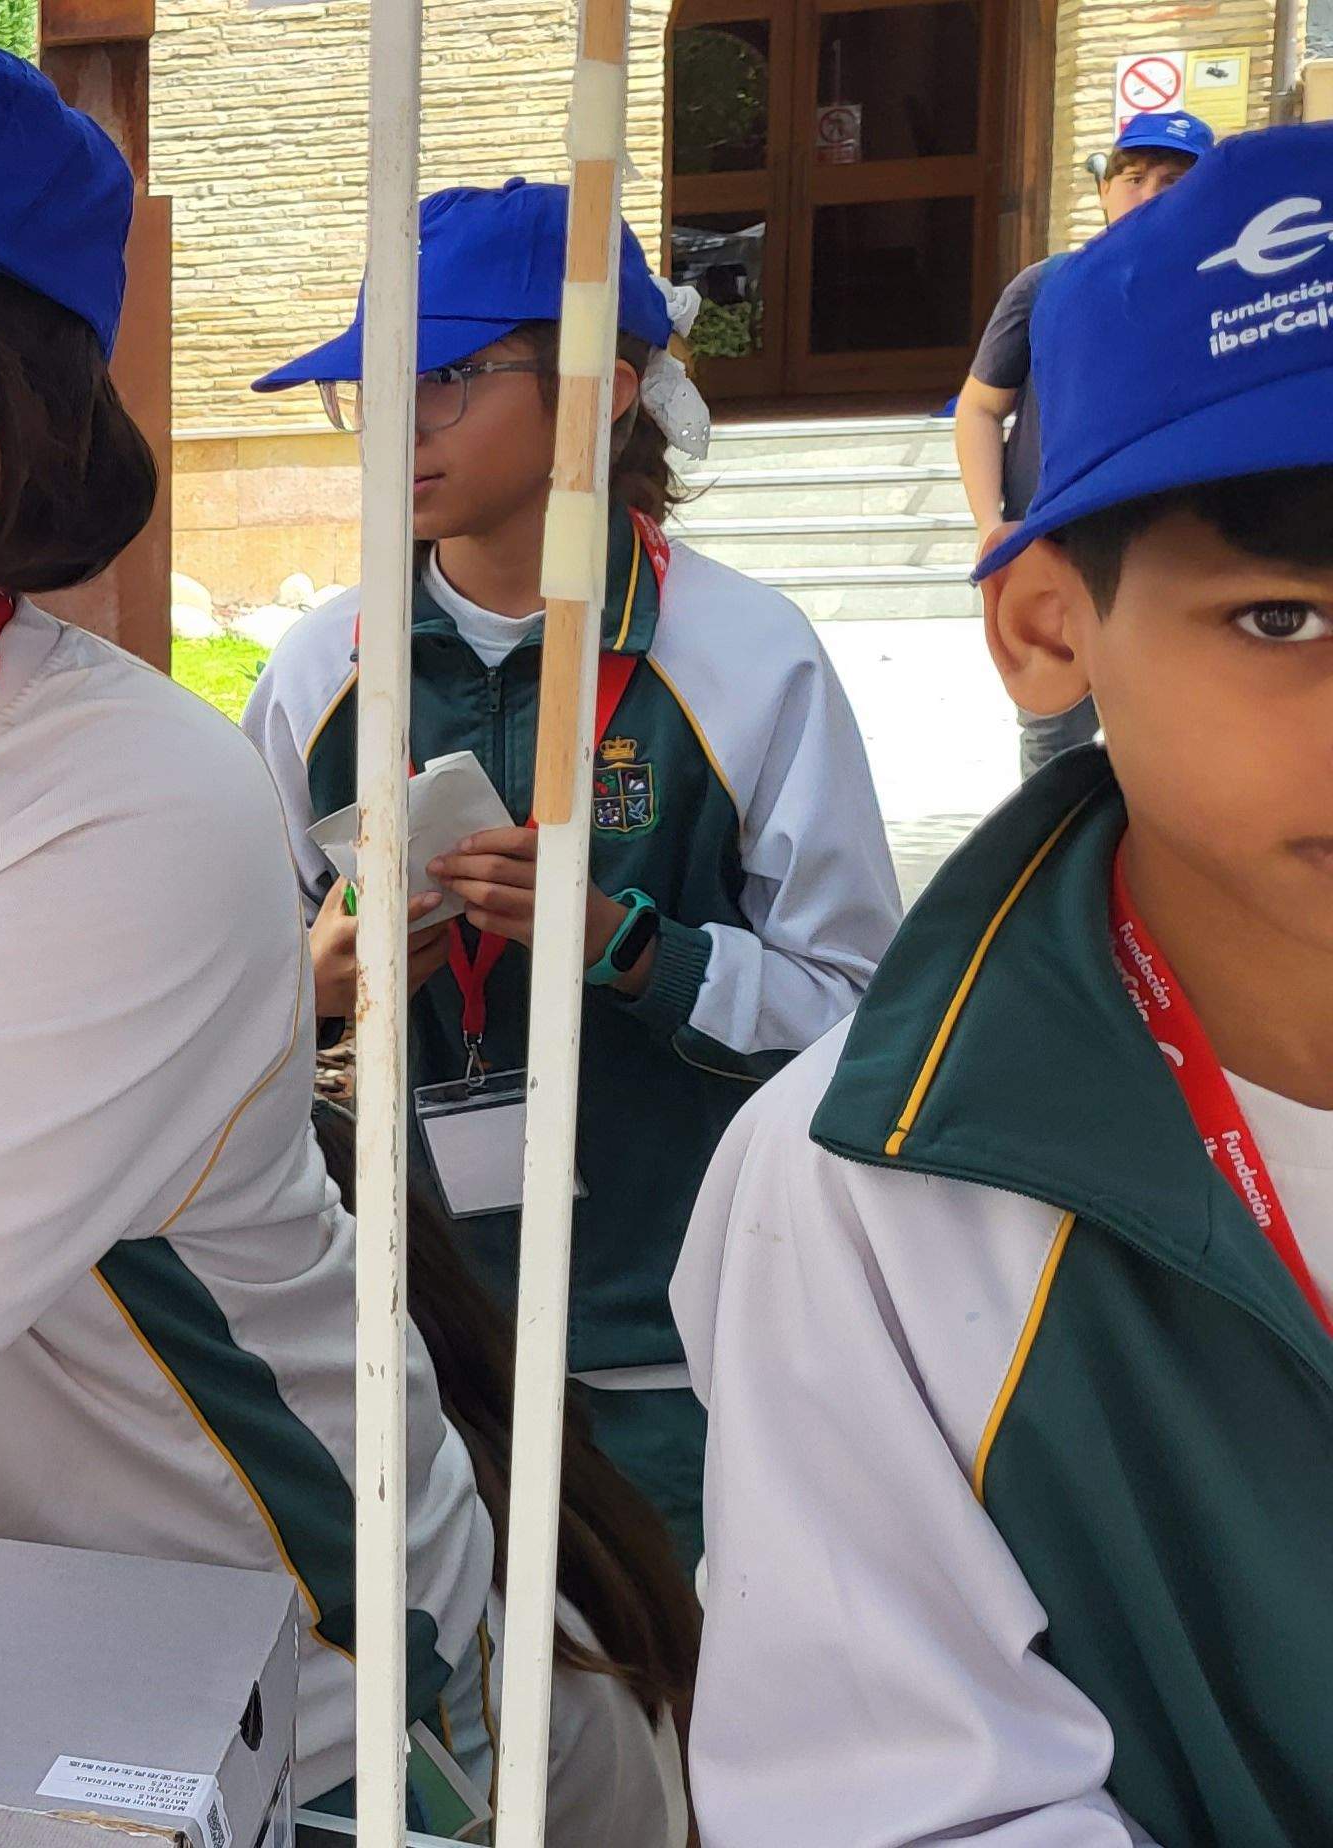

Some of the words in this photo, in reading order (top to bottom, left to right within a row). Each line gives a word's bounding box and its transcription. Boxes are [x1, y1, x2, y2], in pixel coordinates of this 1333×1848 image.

[1209, 301, 1333, 356] iberCaj
[1118, 920, 1171, 1010] Fundación
[1221, 1129, 1272, 1229] Fundación
[127, 1783, 146, 1791] DES
[148, 1786, 171, 1795] AVEC
[85, 1791, 132, 1804] RECYCLED
[173, 1790, 194, 1798] FAIT
[133, 1800, 157, 1808] WITH
[138, 1794, 189, 1806] MATERIALS
[159, 1803, 186, 1811] MADE
